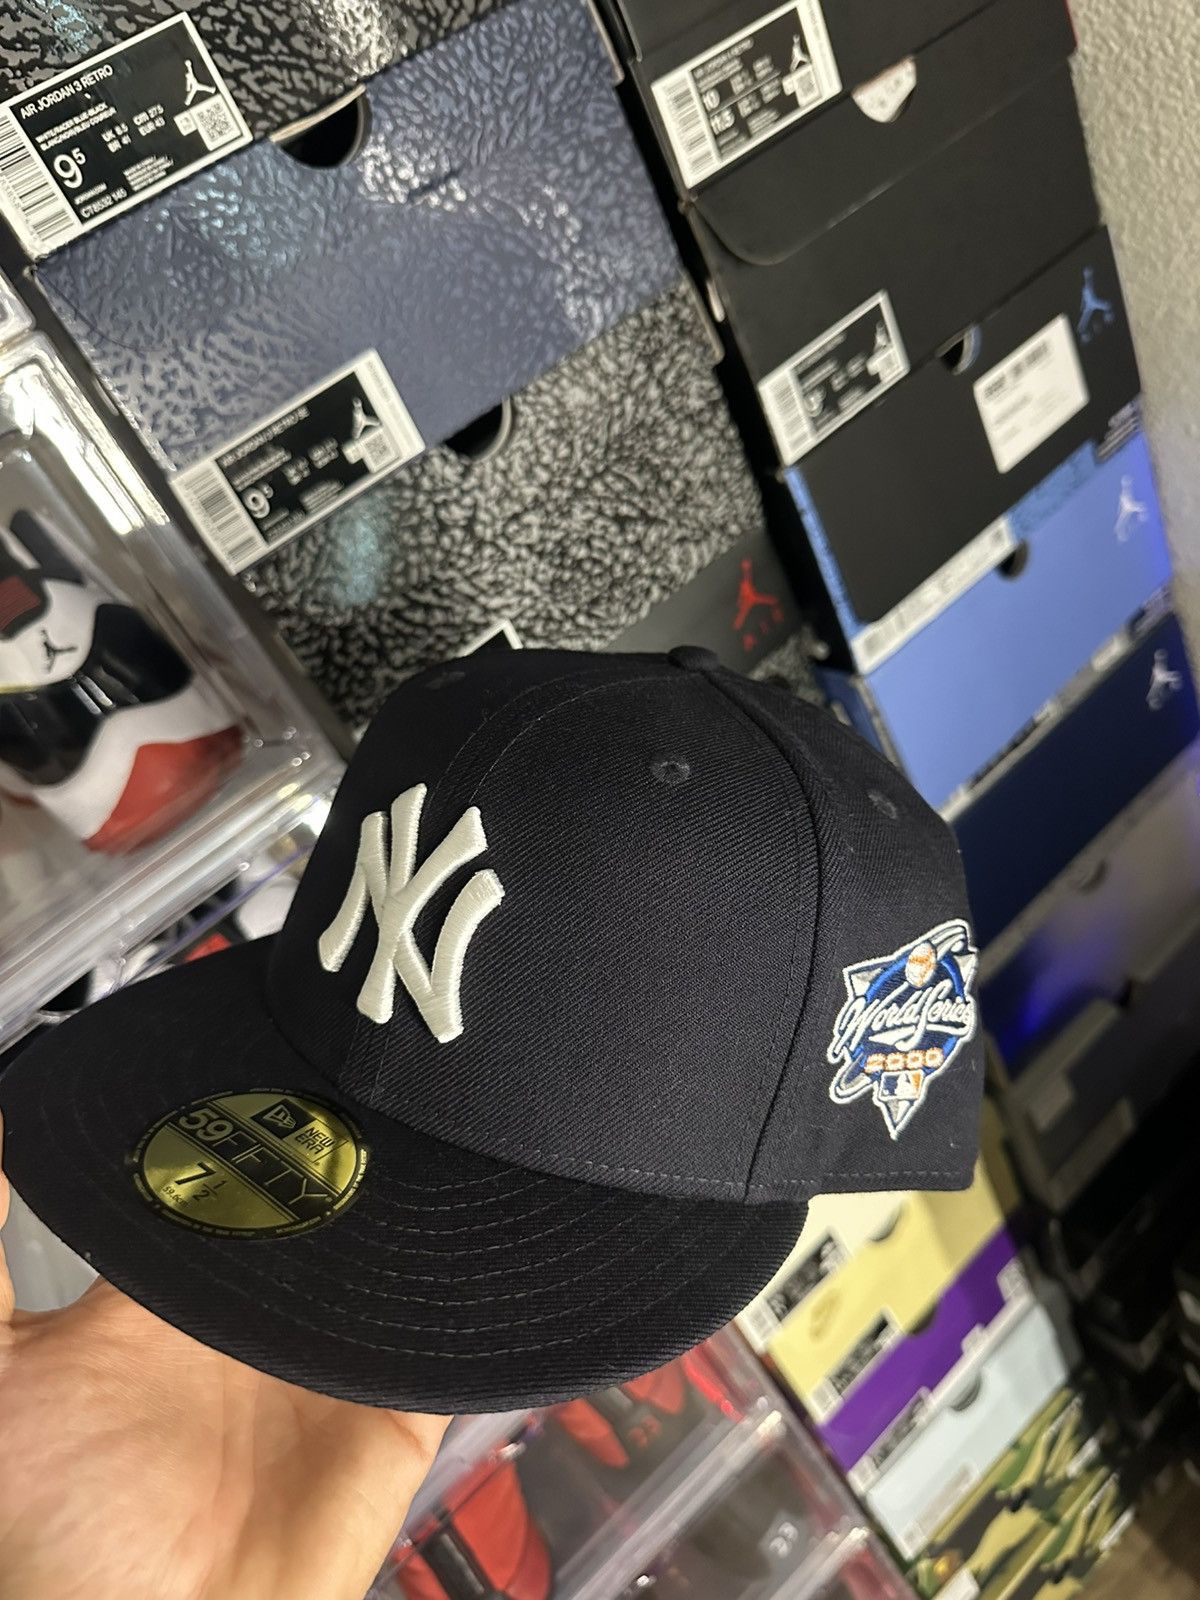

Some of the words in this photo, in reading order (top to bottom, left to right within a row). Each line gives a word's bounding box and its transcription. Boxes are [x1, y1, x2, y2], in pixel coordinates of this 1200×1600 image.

[20, 105, 38, 119] AIR
[38, 85, 76, 111] JORDAN
[73, 81, 82, 92] 3
[81, 64, 113, 86] RETRO
[318, 783, 505, 1044] NY
[864, 1047, 945, 1074] 2000
[294, 1133, 325, 1154] ERA
[304, 1126, 335, 1147] NEW
[179, 1108, 329, 1205] 59FIFTY
[175, 1162, 216, 1186] 7
